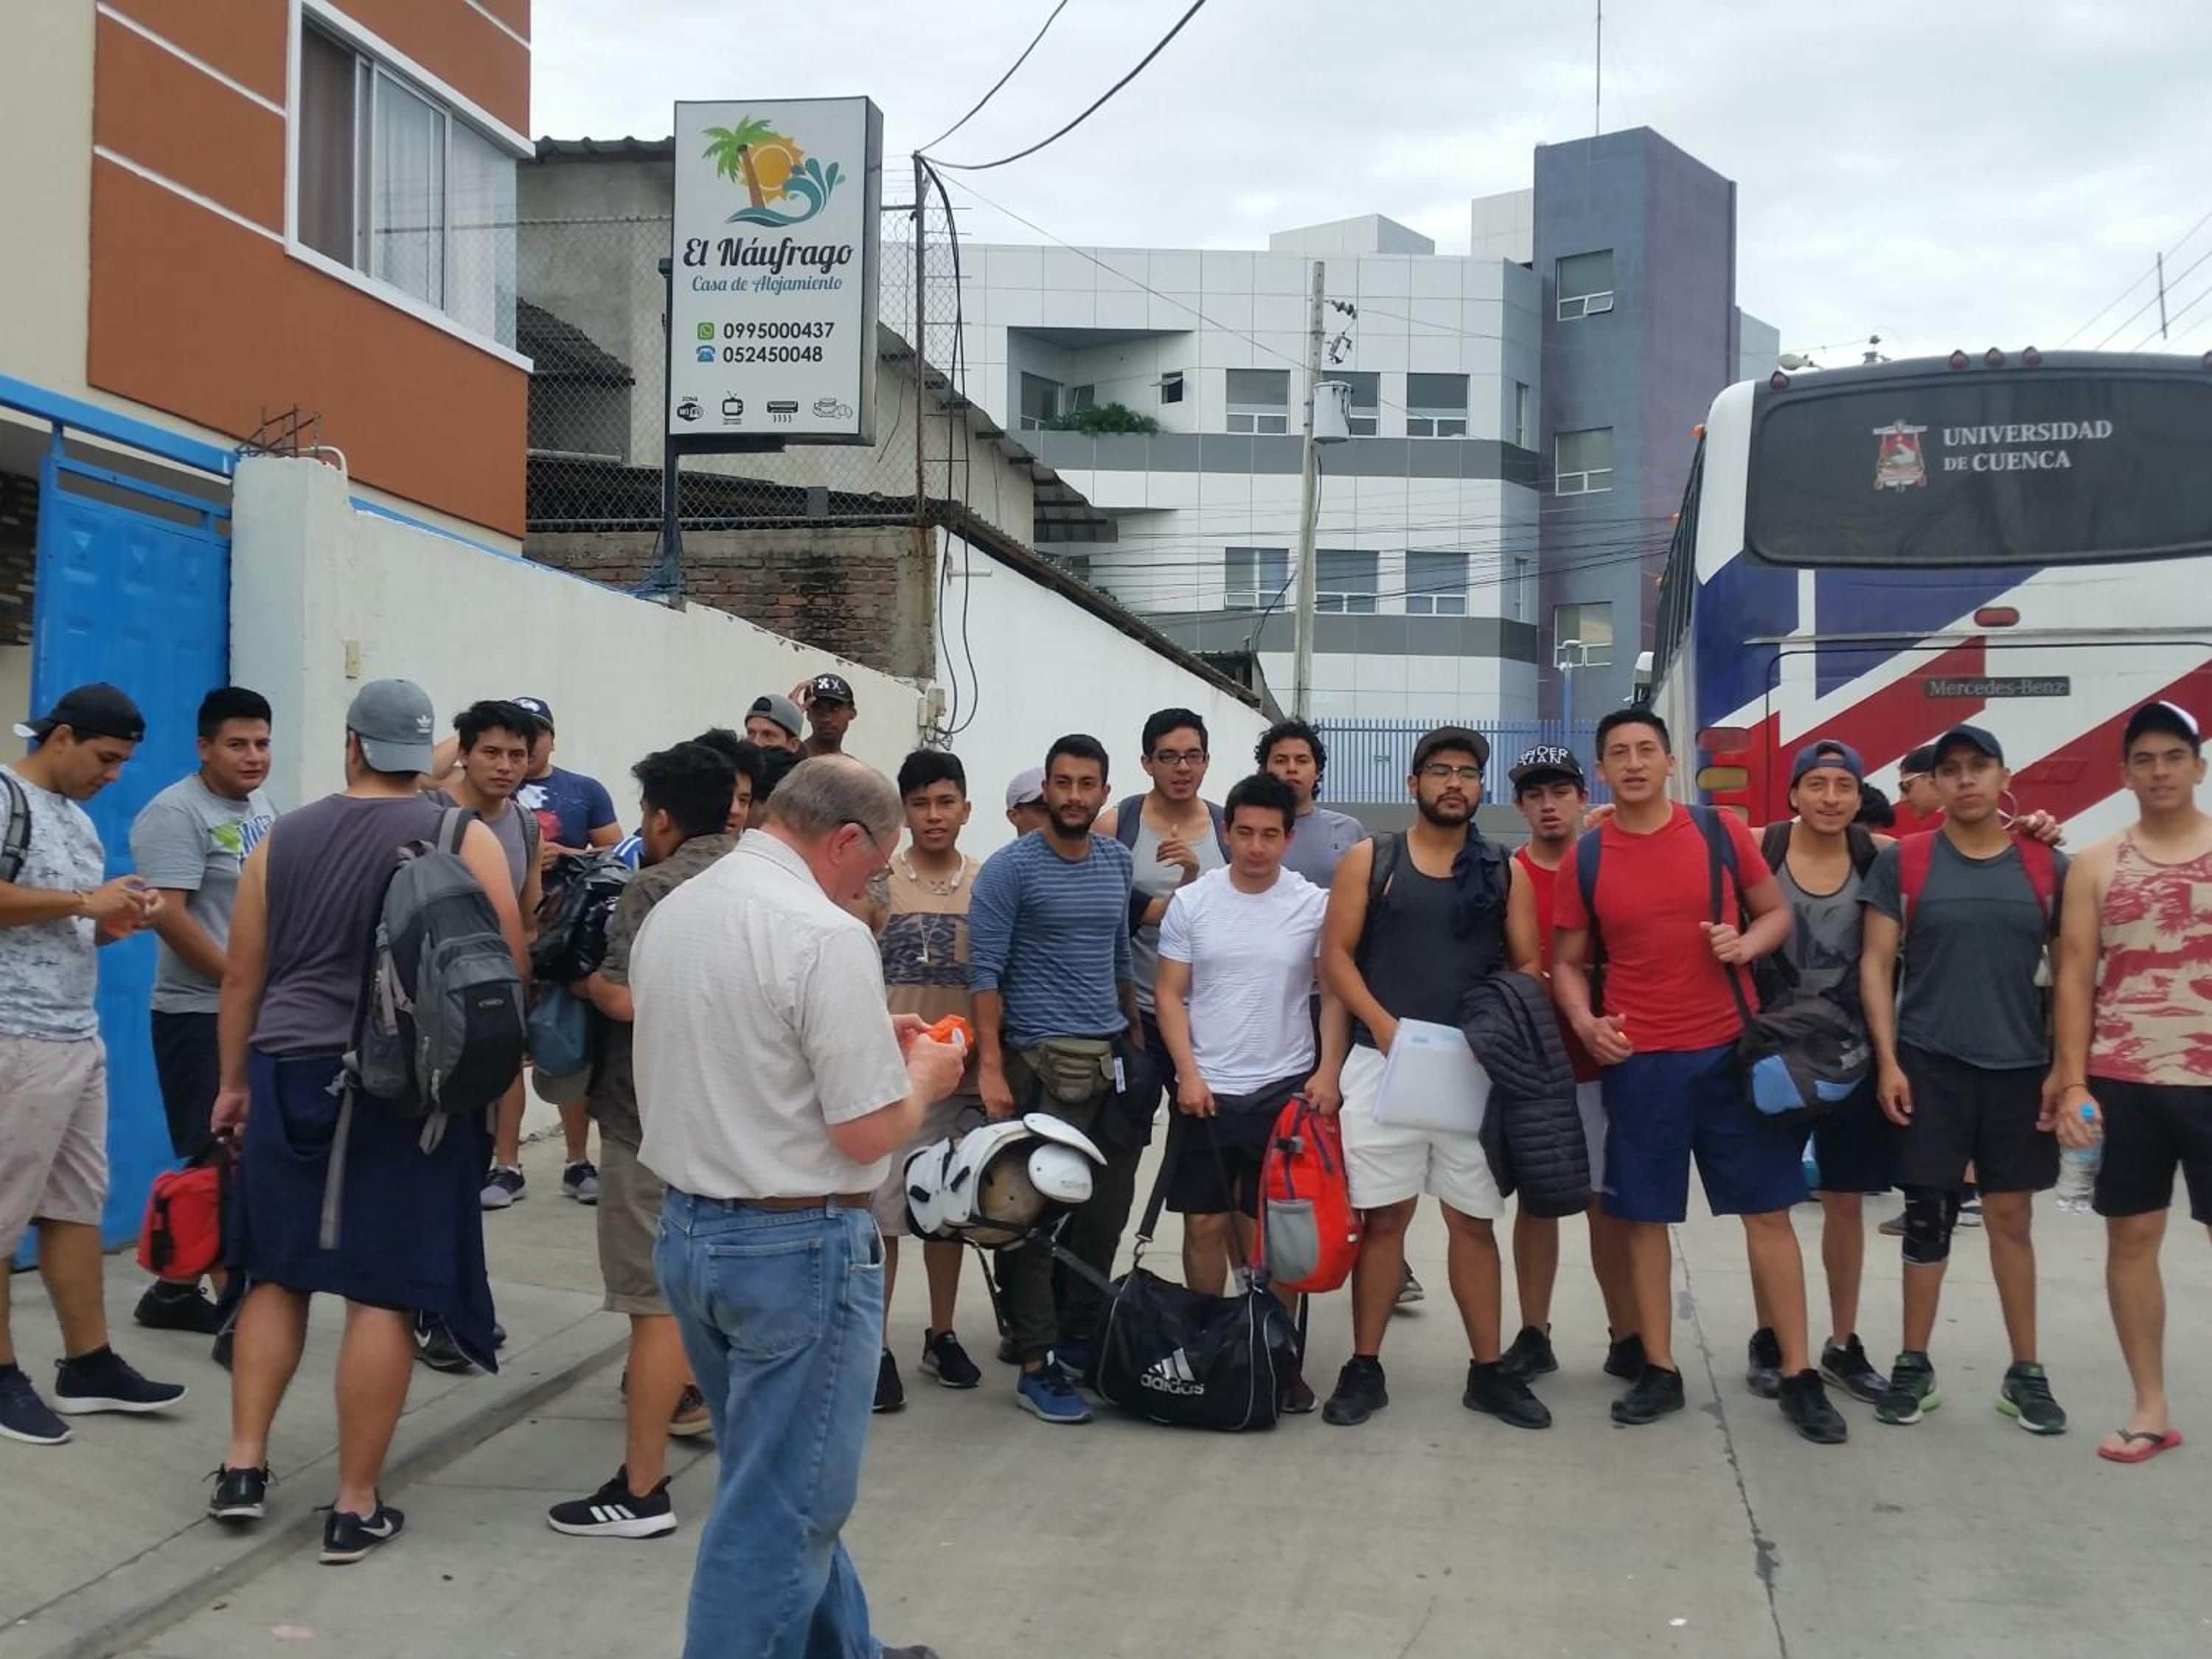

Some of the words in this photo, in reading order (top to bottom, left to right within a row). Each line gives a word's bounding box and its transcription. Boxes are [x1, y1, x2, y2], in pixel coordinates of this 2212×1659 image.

[684, 237, 709, 266] El
[717, 237, 853, 274] Náufrago
[692, 274, 728, 291] Casa
[731, 276, 748, 291] de
[753, 275, 843, 295] Alojamiento
[723, 321, 835, 339] 0995000437
[723, 345, 823, 363] 052450048
[1943, 420, 2113, 446] UNIVERSIDAD
[1944, 457, 1969, 471] DE
[1972, 450, 2072, 472] CUENCA
[1928, 678, 2066, 696] Mercedes-Benz
